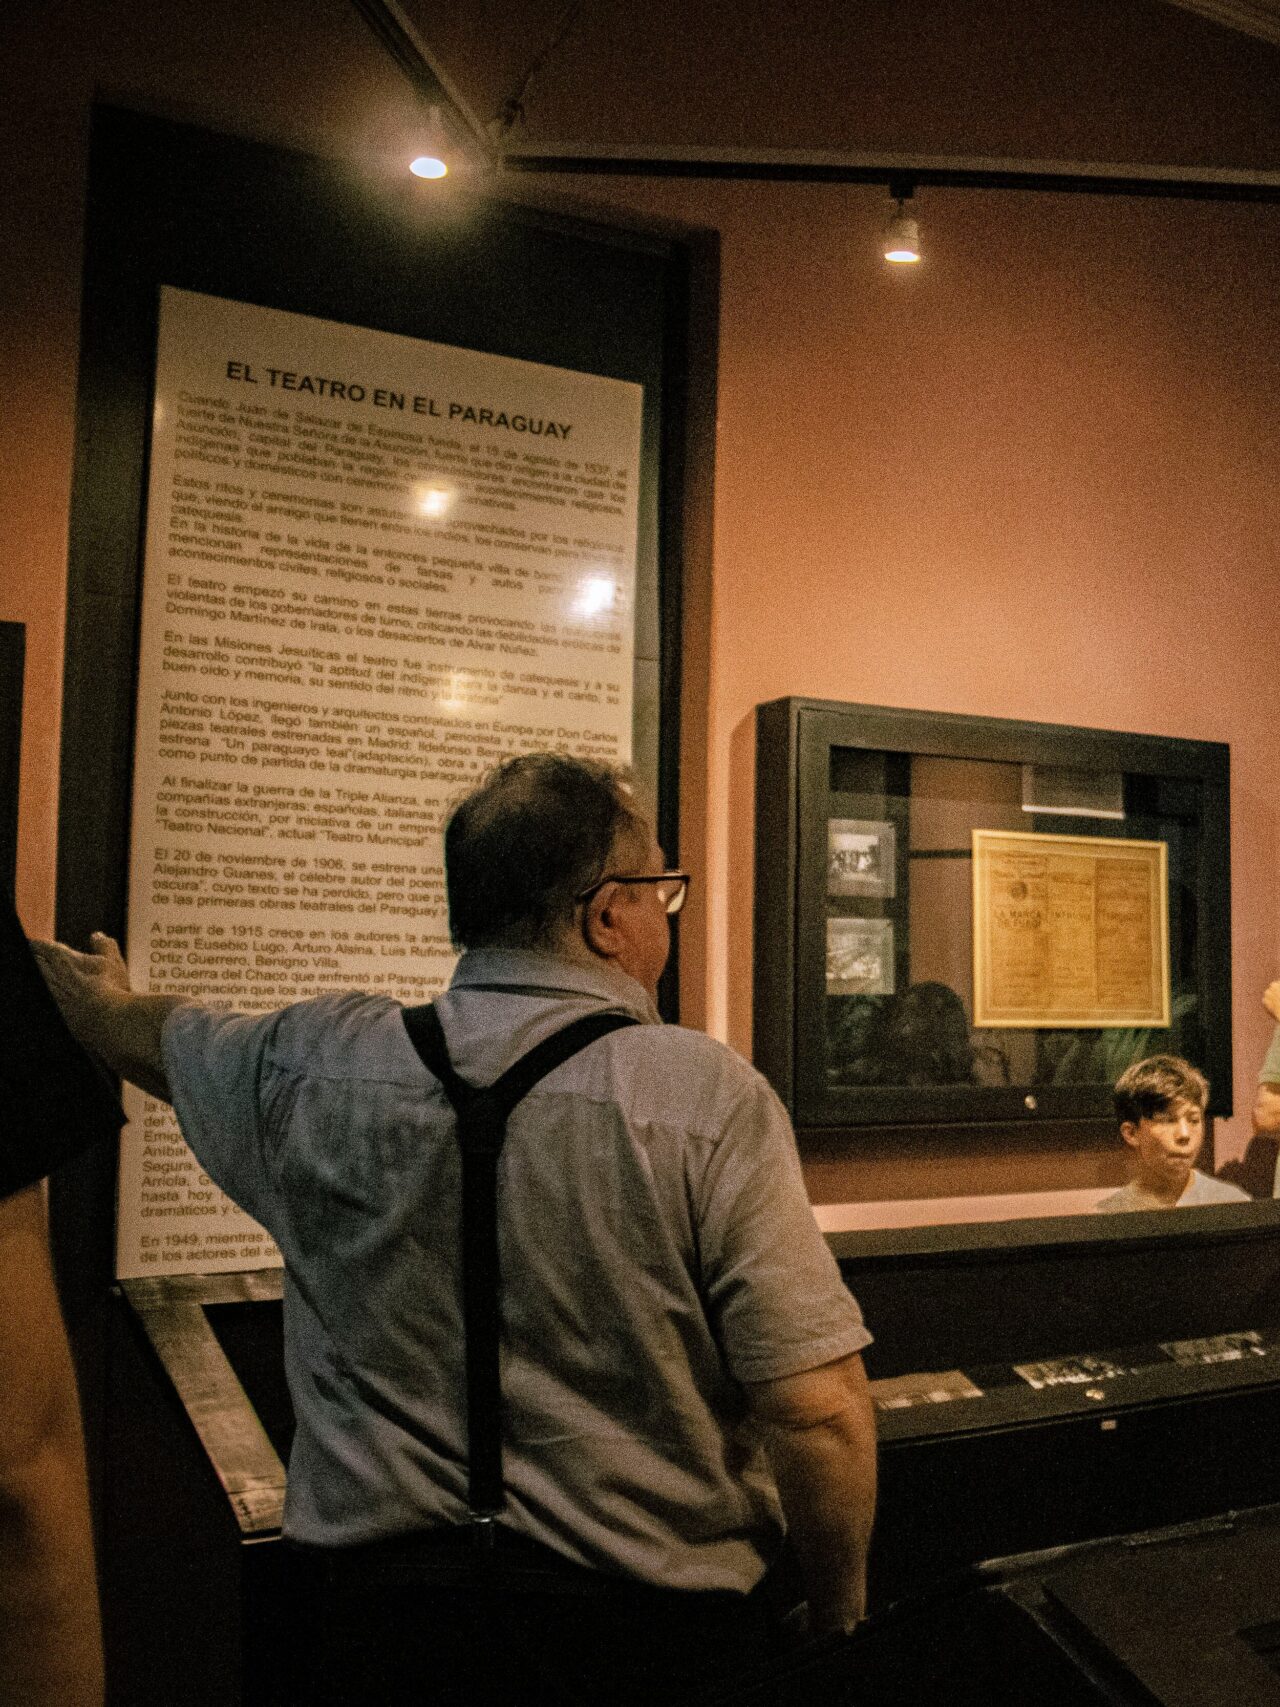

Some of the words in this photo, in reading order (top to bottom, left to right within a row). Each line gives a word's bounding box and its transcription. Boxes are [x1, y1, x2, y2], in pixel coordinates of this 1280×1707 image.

[226, 360, 258, 383] EL
[268, 368, 366, 402] TEATRO
[373, 388, 405, 410] EN
[413, 395, 441, 416] EL
[448, 402, 571, 440] PARAGUAY
[163, 775, 176, 786] Al
[180, 777, 232, 790] finalizar
[236, 781, 248, 792] la
[253, 784, 295, 797] guerra
[299, 786, 315, 797] de
[319, 788, 330, 798] la
[336, 789, 369, 803] Triple
[424, 798, 439, 806] en
[155, 804, 168, 815] la
[268, 814, 289, 825] por
[296, 814, 350, 827] iniciativa
[356, 819, 371, 829] de
[377, 822, 392, 830] un
[384, 807, 433, 820] italianas
[278, 827, 316, 839] actual
[154, 848, 168, 859] El
[174, 849, 190, 860] 20
[195, 851, 212, 862] de
[217, 852, 286, 866] noviembre
[291, 856, 306, 867] de
[352, 862, 366, 870] se
[371, 861, 416, 873] estrena
[421, 866, 441, 875] una
[154, 863, 218, 879] Alejandro
[283, 870, 294, 880] el
[299, 871, 345, 883] célebre
[351, 874, 381, 885] autor
[386, 876, 404, 886] del
[212, 883, 244, 894] cuyo
[247, 883, 279, 894] texto
[283, 886, 298, 895] se
[302, 886, 318, 896] ha
[376, 891, 404, 902] pero
[407, 893, 430, 903] que
[152, 893, 169, 903] de
[173, 894, 193, 905] las
[197, 895, 255, 909] primeras
[259, 898, 296, 909] obras
[299, 900, 353, 912] teatrales
[358, 902, 376, 913] del
[151, 922, 161, 932] A
[166, 923, 201, 936] partir
[207, 924, 224, 935] de
[232, 925, 263, 936] 1915
[268, 928, 304, 938] crece
[309, 930, 325, 938] en
[331, 929, 349, 939] los
[354, 930, 400, 941] autores
[405, 932, 416, 942] la
[150, 937, 188, 948] obras
[193, 939, 248, 950] Eusebio
[293, 942, 331, 953] Arturo
[380, 945, 406, 955] Luis
[150, 952, 182, 963] Ortiz
[255, 955, 308, 968] Benigno
[149, 967, 167, 978] La
[170, 968, 218, 979] Guerra
[221, 969, 241, 979] del
[245, 970, 287, 980] Chaco
[291, 972, 315, 983] que
[318, 971, 370, 982] enfrentó
[373, 973, 384, 982] al
[387, 973, 444, 986] Paraguay
[148, 981, 160, 992] la
[165, 982, 248, 996] marginación
[250, 986, 275, 996] que
[278, 984, 297, 994] los
[396, 987, 410, 997] de
[415, 988, 425, 997] la
[144, 1115, 164, 1126] del
[140, 1190, 179, 1201] hasta
[187, 1188, 212, 1202] hoy
[220, 1204, 229, 1215] y
[140, 1236, 160, 1247] En
[205, 1230, 262, 1243] mientras
[140, 1251, 158, 1263] de
[162, 1250, 182, 1261] los
[186, 1247, 236, 1260] actores
[240, 1245, 260, 1256] del
